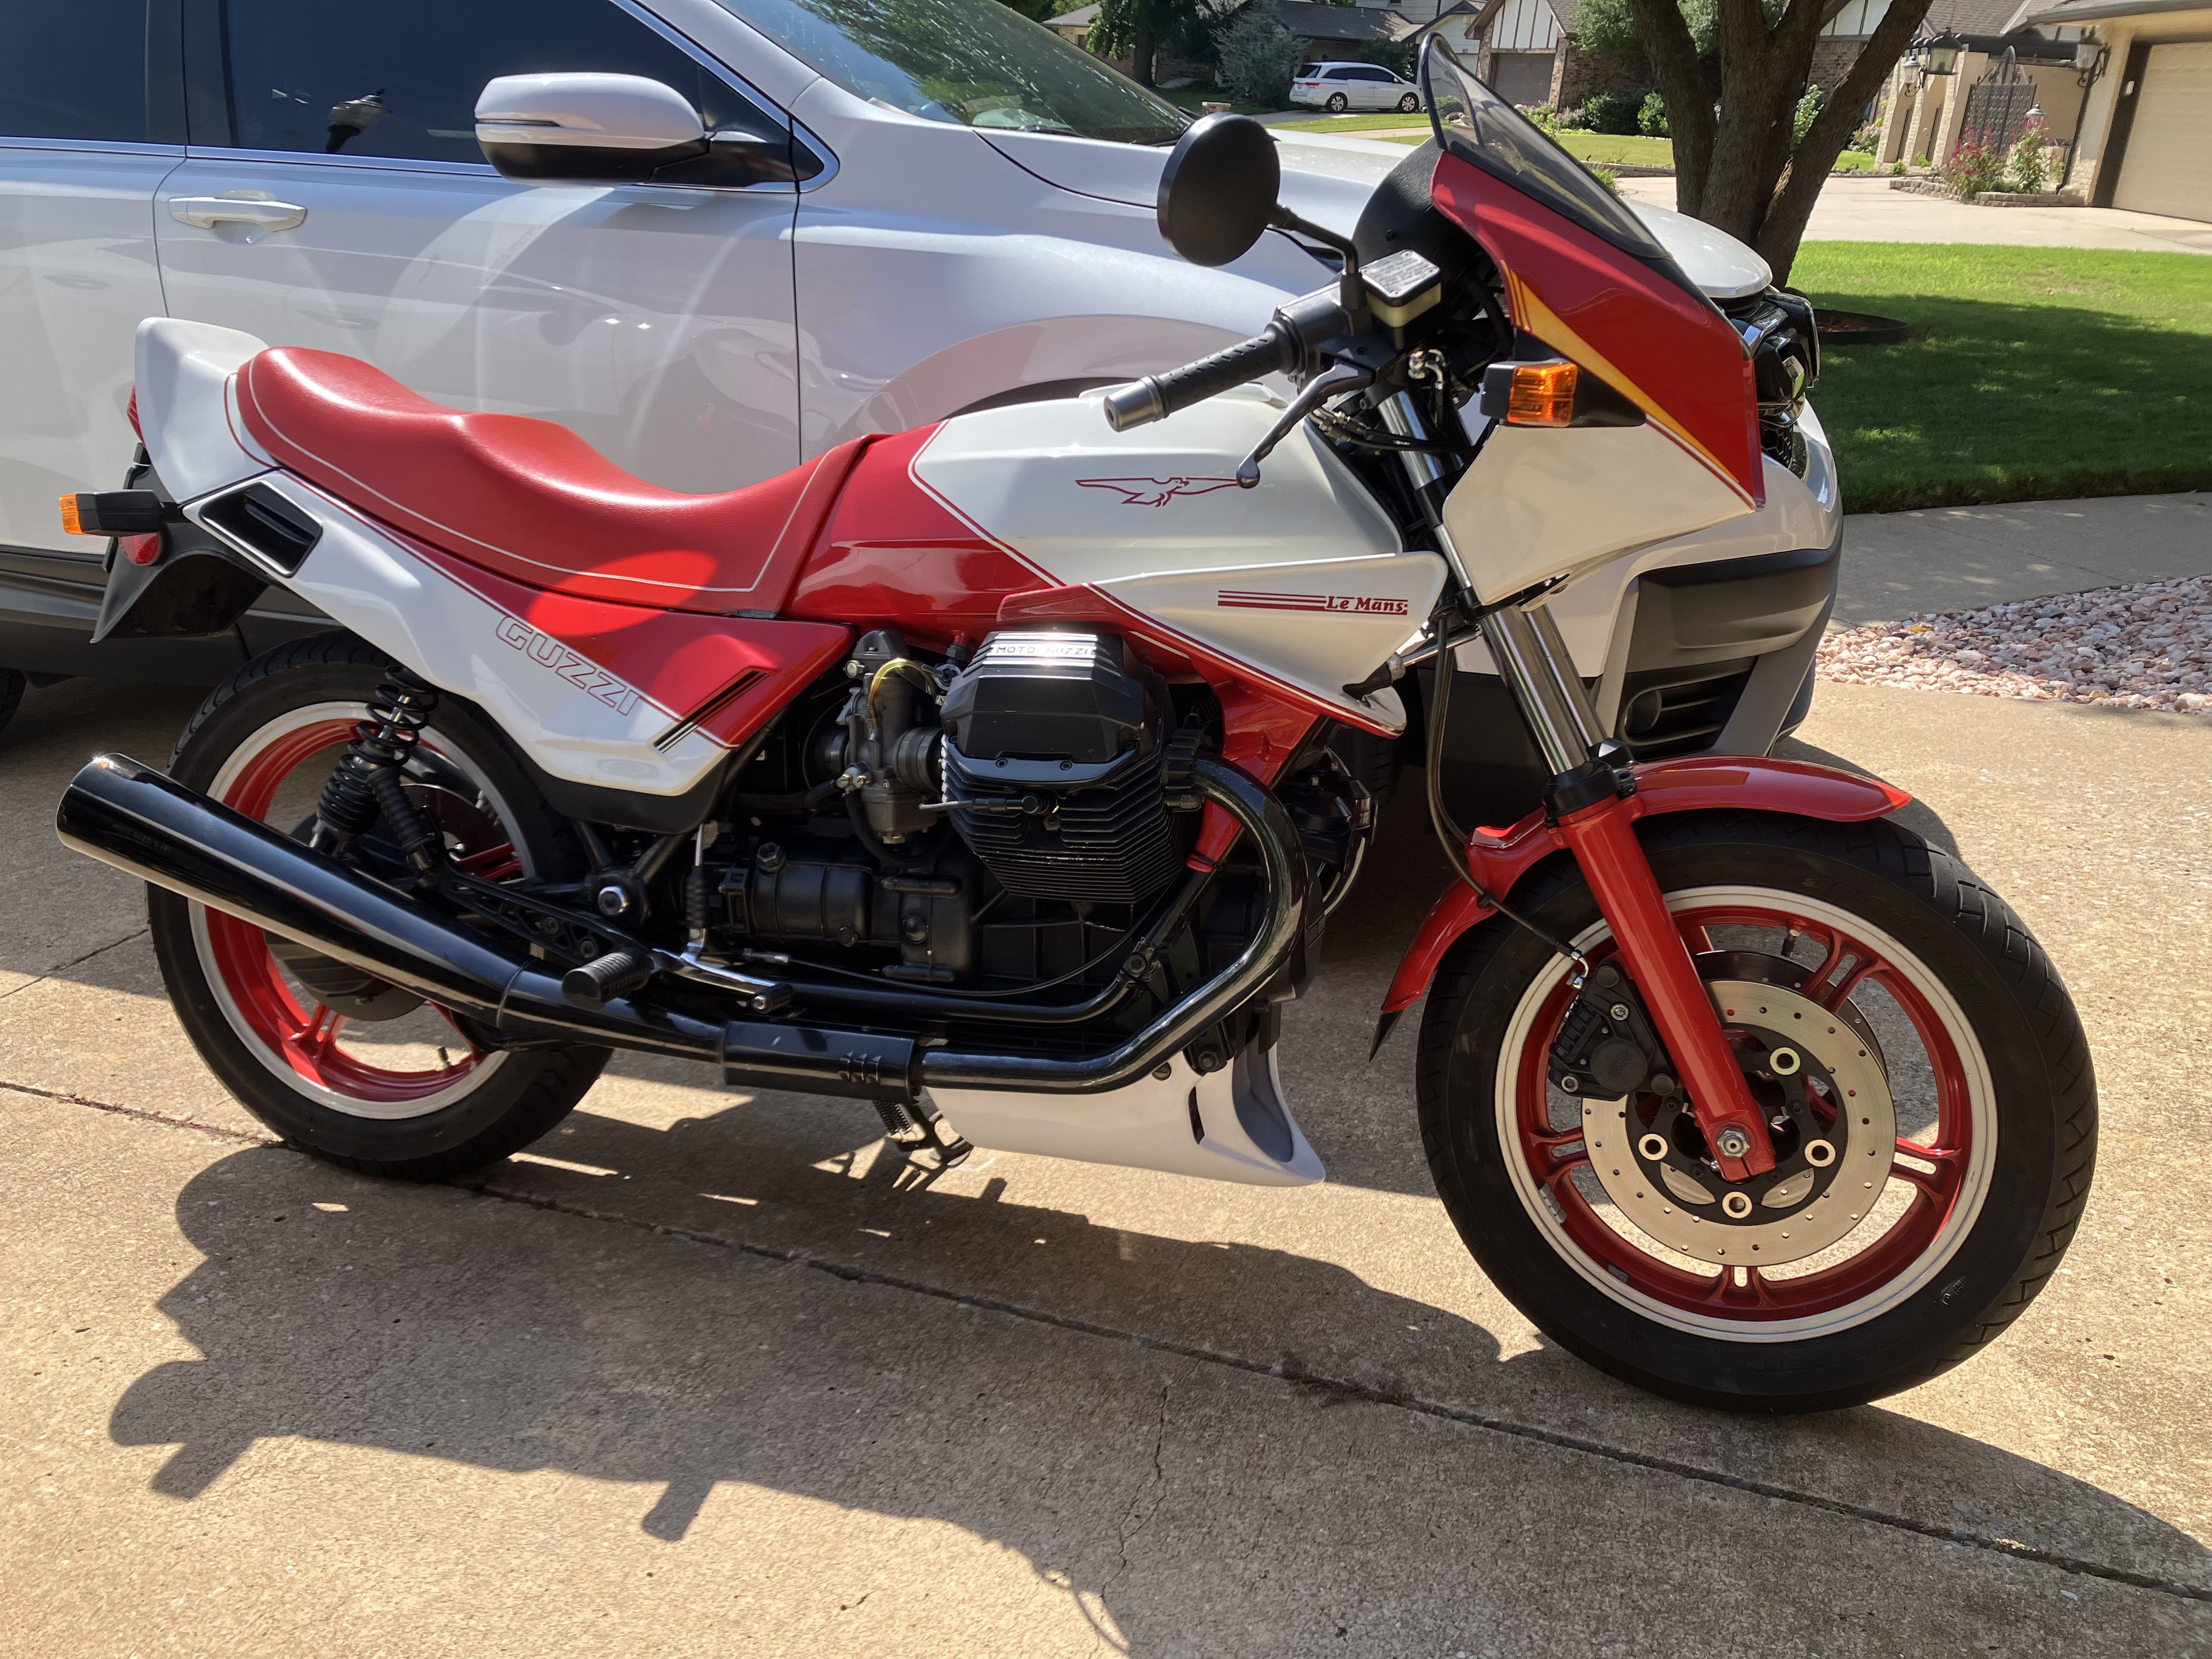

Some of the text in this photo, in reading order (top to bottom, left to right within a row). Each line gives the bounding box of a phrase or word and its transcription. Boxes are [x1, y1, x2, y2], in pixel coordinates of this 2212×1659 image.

[1326, 596, 1403, 612] Le Mans
[496, 616, 640, 716] GUZZI
[133, 832, 153, 844] GUZZI
